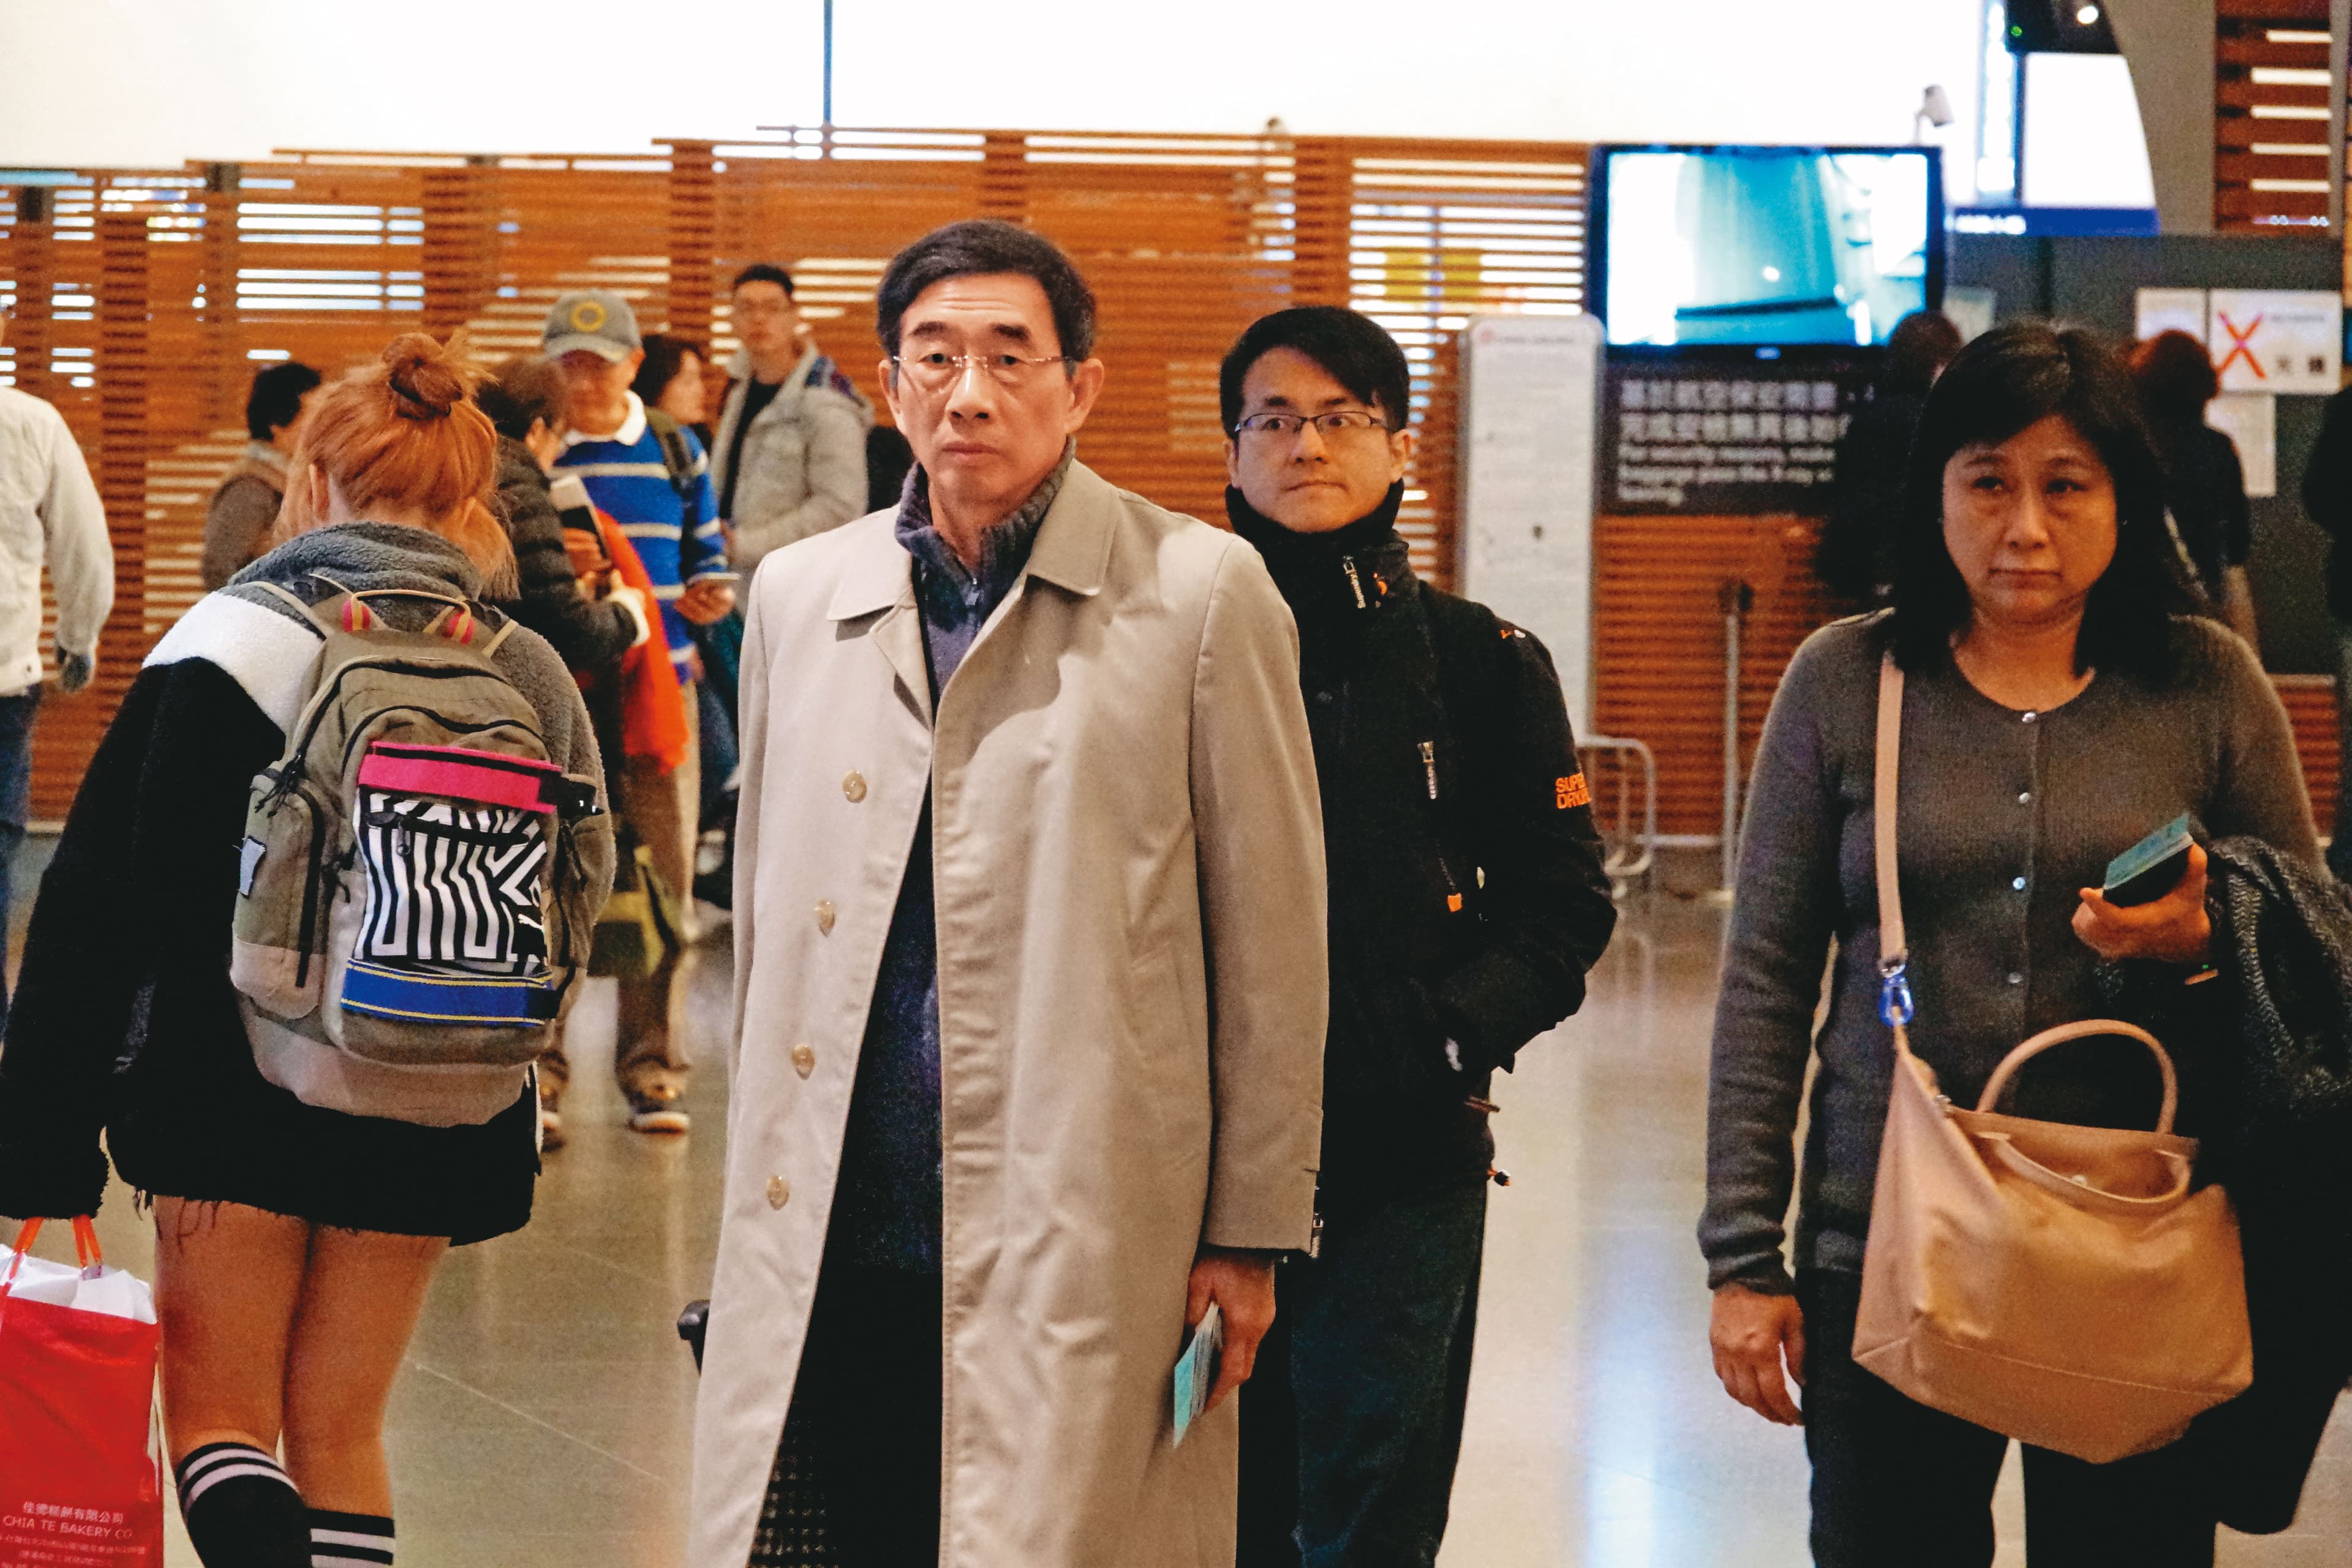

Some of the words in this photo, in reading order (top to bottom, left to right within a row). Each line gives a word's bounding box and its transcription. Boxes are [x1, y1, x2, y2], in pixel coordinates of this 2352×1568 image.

[2, 1515, 35, 1529] CHIA
[40, 1519, 56, 1531] TE
[60, 1522, 111, 1538] BAKERY
